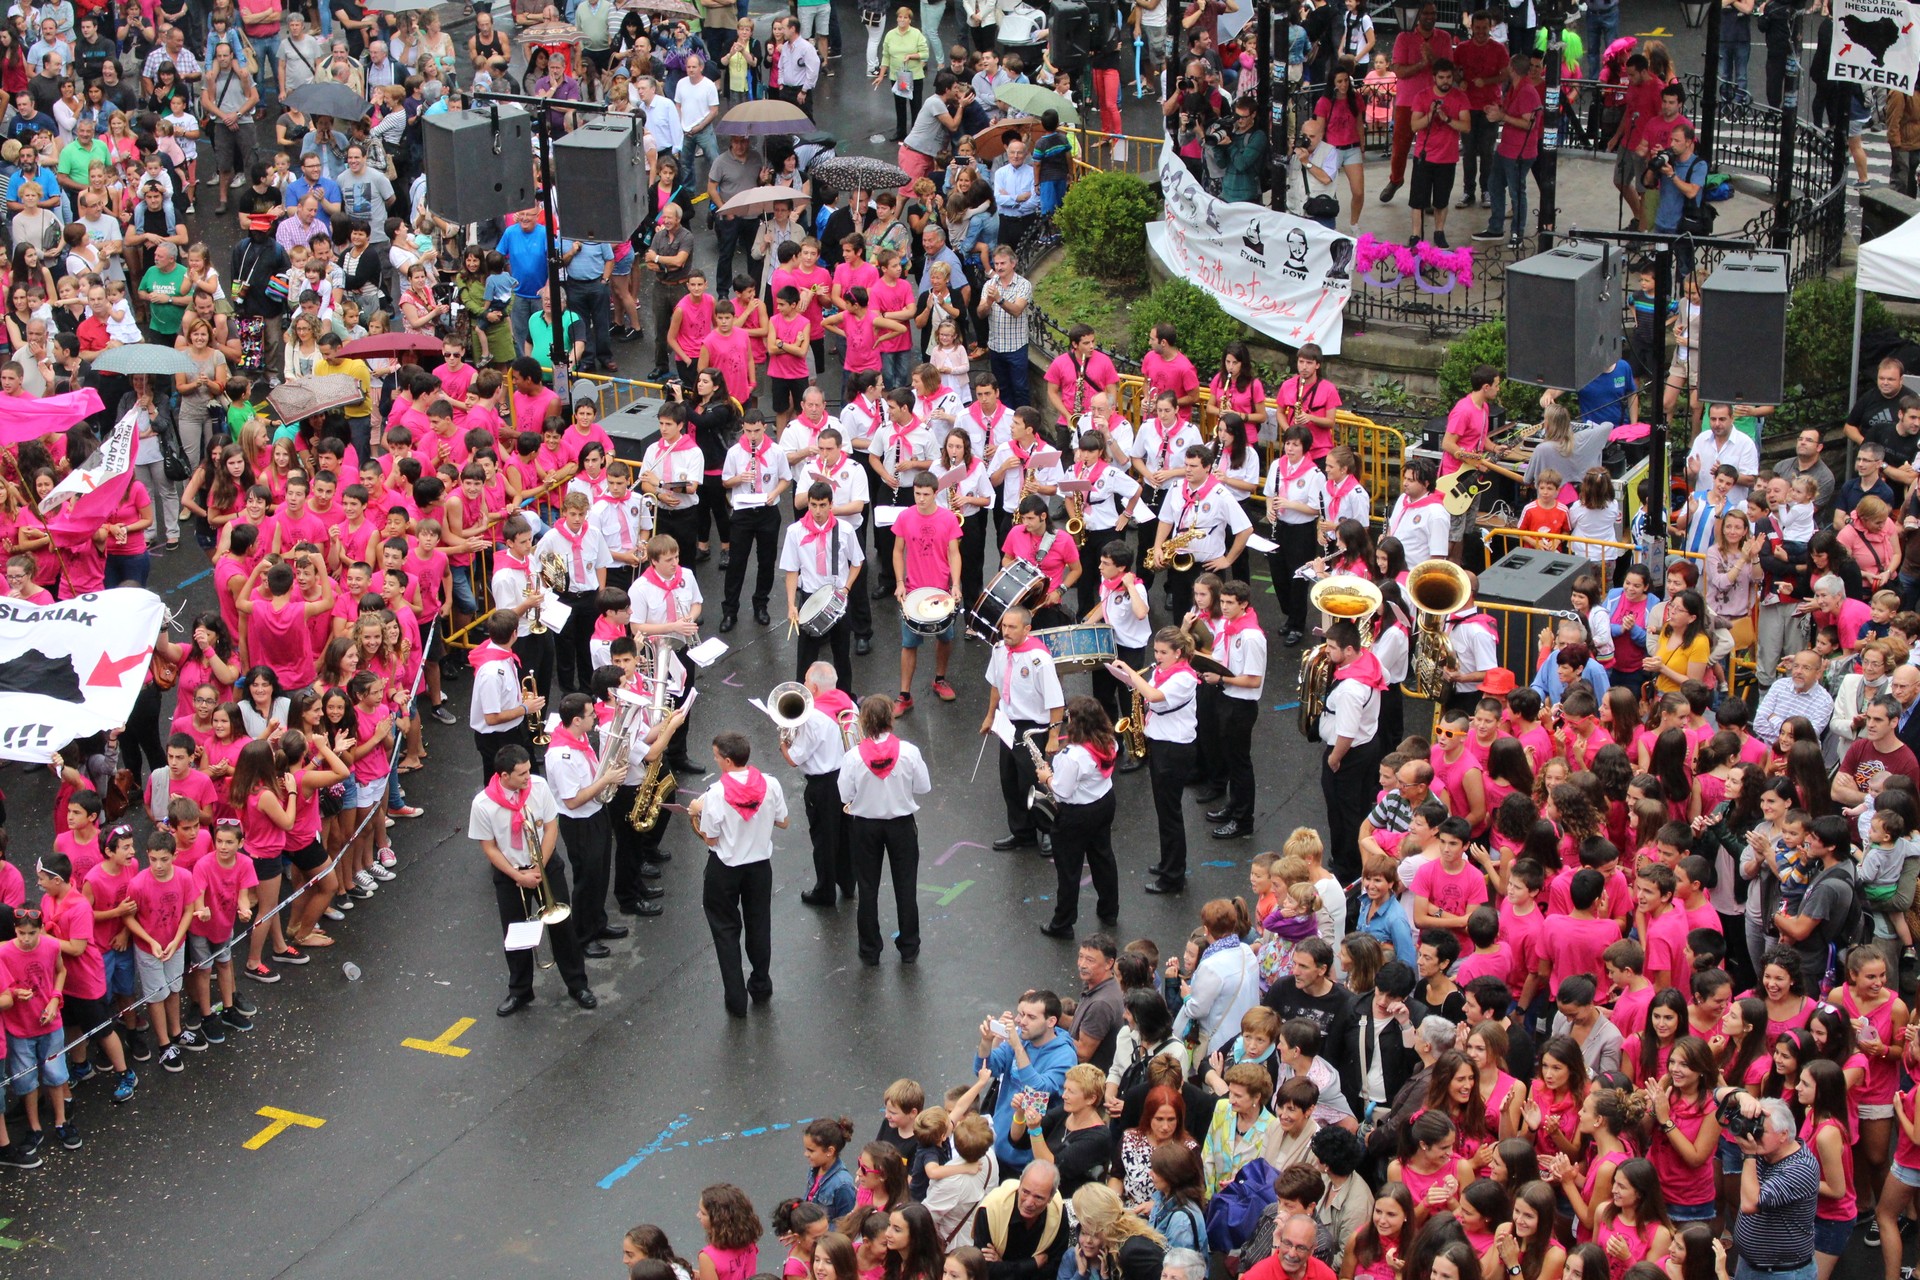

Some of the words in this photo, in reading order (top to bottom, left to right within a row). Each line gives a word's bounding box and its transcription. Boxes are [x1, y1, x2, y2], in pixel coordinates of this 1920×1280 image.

[1845, 2, 1903, 17] IHESLARIAK
[1835, 63, 1909, 90] ETXERA
[1240, 249, 1266, 269] ETXARTE
[1283, 268, 1307, 281] POW
[119, 424, 132, 455] PRESO
[115, 457, 125, 474] ETA
